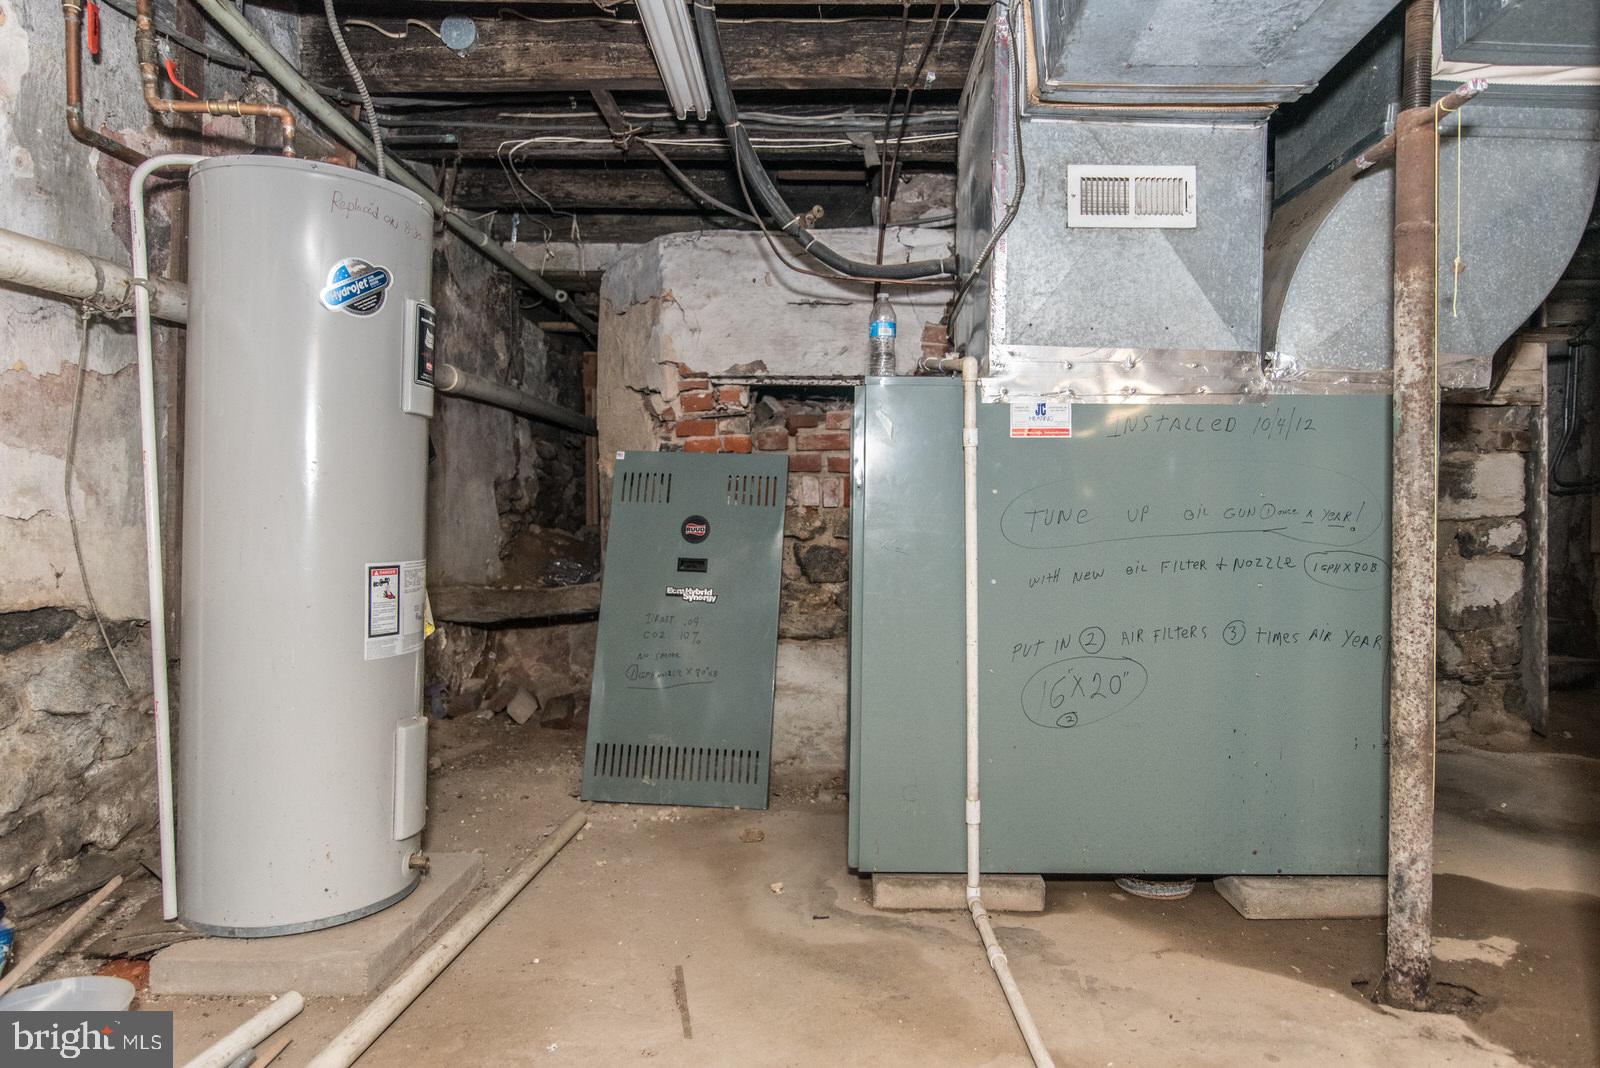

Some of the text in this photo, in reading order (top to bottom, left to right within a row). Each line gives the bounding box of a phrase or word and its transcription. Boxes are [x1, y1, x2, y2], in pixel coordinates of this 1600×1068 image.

[1035, 402, 1047, 416] JC
[1252, 407, 1316, 440] 10/4/12
[1127, 505, 1150, 522] UP
[1223, 507, 1256, 520] GUN
[683, 594, 717, 604] Synergy
[1054, 634, 1071, 654] IN
[1121, 628, 1144, 646] AIR
[1308, 628, 1333, 642] AIR
